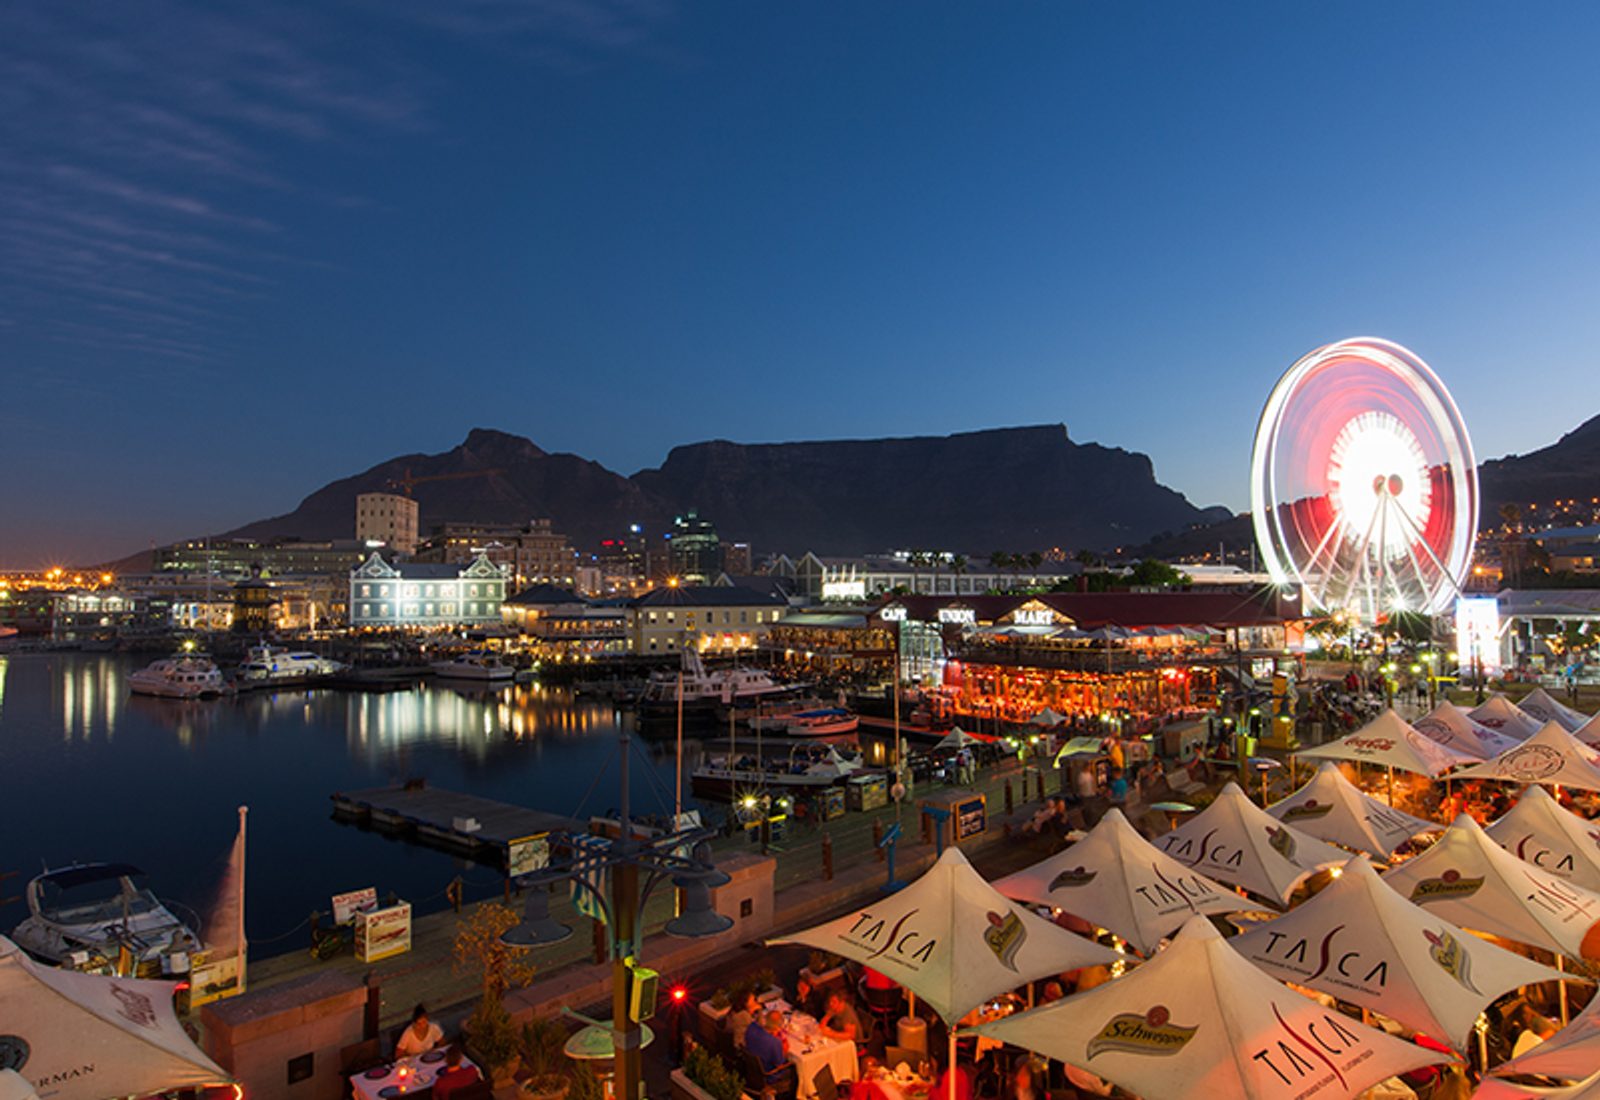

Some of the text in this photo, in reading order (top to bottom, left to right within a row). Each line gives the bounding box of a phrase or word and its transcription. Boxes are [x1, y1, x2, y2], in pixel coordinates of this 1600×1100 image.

[938, 609, 975, 623] UNION
[1014, 610, 1054, 624] MART
[1164, 828, 1244, 867] TASCA
[1136, 862, 1213, 913] TASCA
[849, 908, 937, 963] TASCA
[1265, 924, 1388, 987] TASCA
[1253, 1001, 1360, 1091] TASCA
